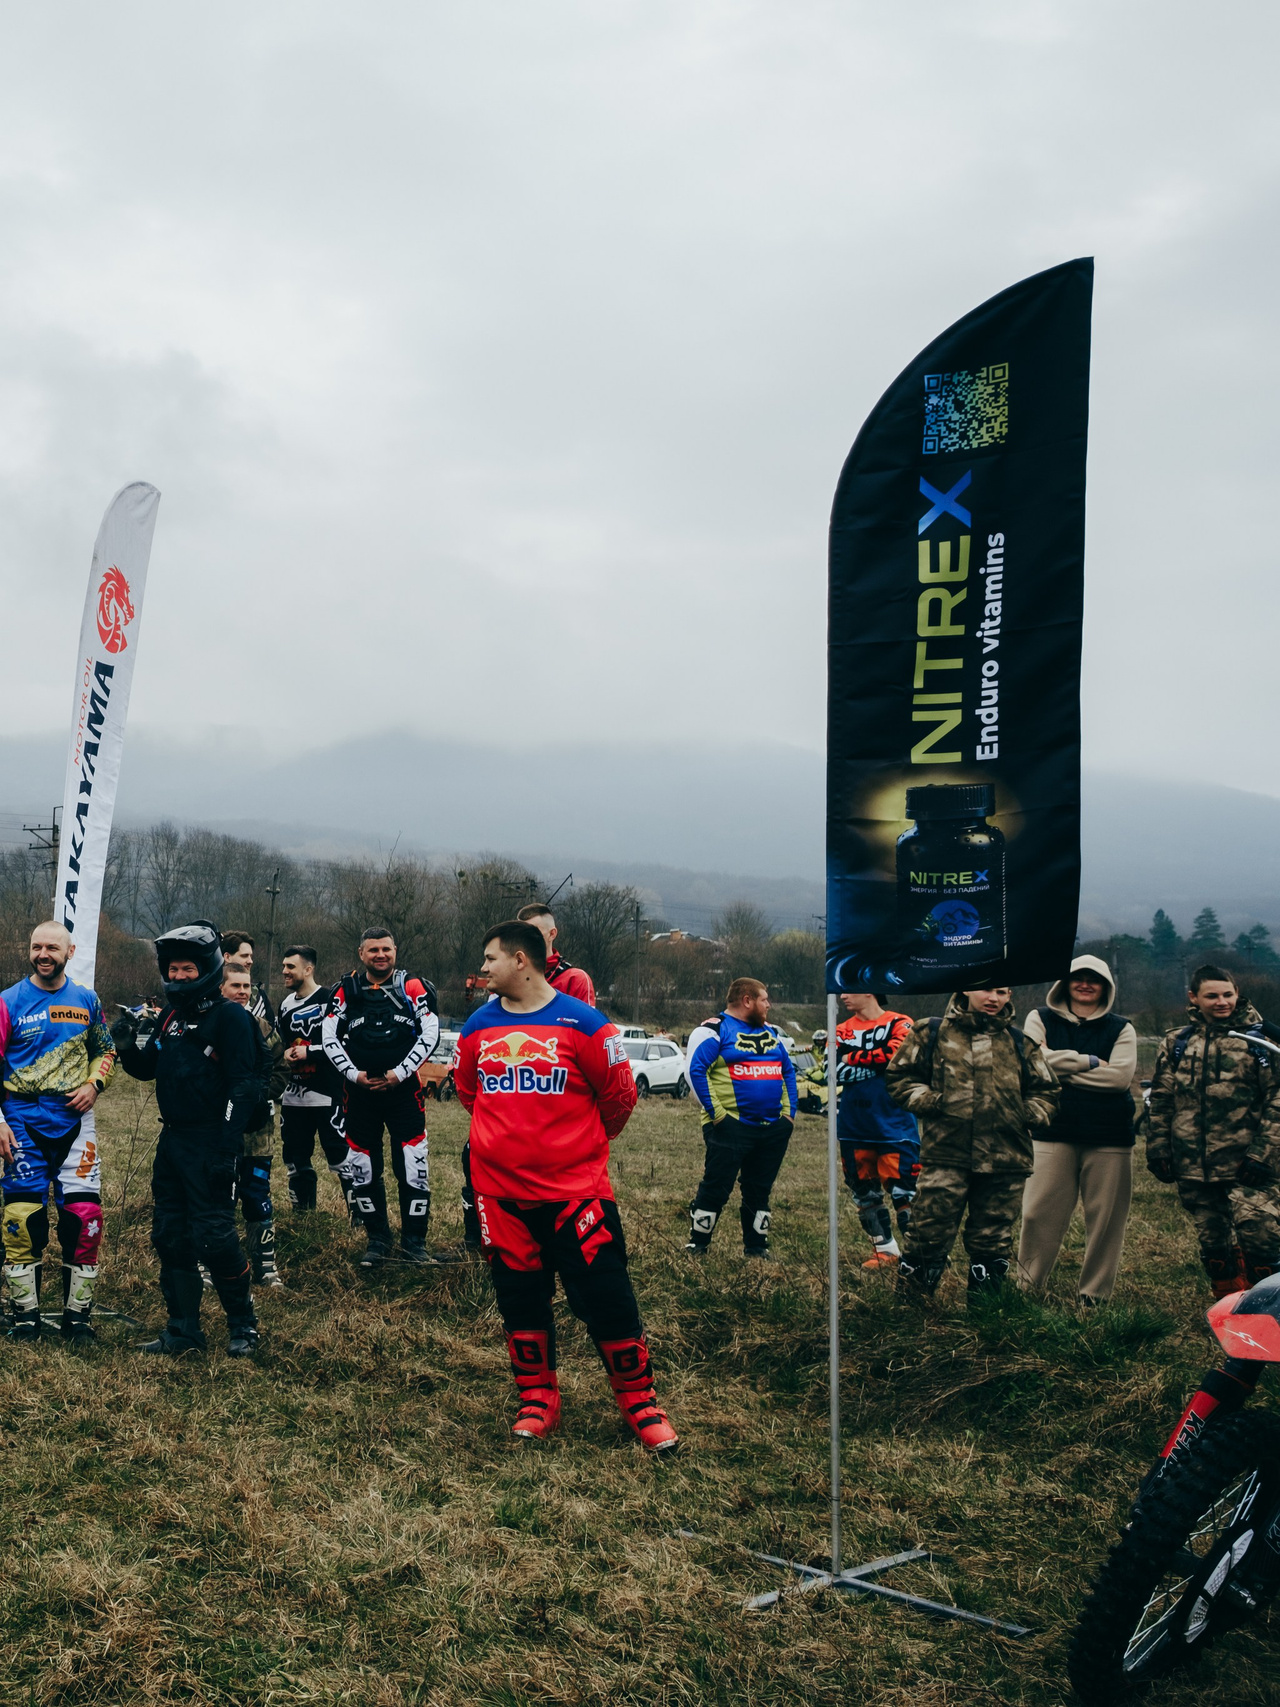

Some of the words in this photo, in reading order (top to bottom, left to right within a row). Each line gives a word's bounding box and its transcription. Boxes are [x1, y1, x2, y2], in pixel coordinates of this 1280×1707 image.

[975, 532, 1005, 654] vitamins
[910, 469, 972, 764] NITREX
[73, 692, 88, 766] MOTOR
[83, 656, 93, 688] OIL
[975, 659, 1000, 761] Enduro
[909, 869, 990, 886] NITREX
[958, 884, 990, 894] ПАДЕНИЙ
[943, 934, 973, 942] ЭНДУРО
[943, 939, 984, 947] ВИТАМИНЫ
[18, 1010, 47, 1026] Hard
[50, 1009, 90, 1023] enduro
[733, 1063, 783, 1078] Suprem
[477, 1065, 515, 1095] Red
[517, 1066, 568, 1095] Bull
[408, 1199, 428, 1216] G
